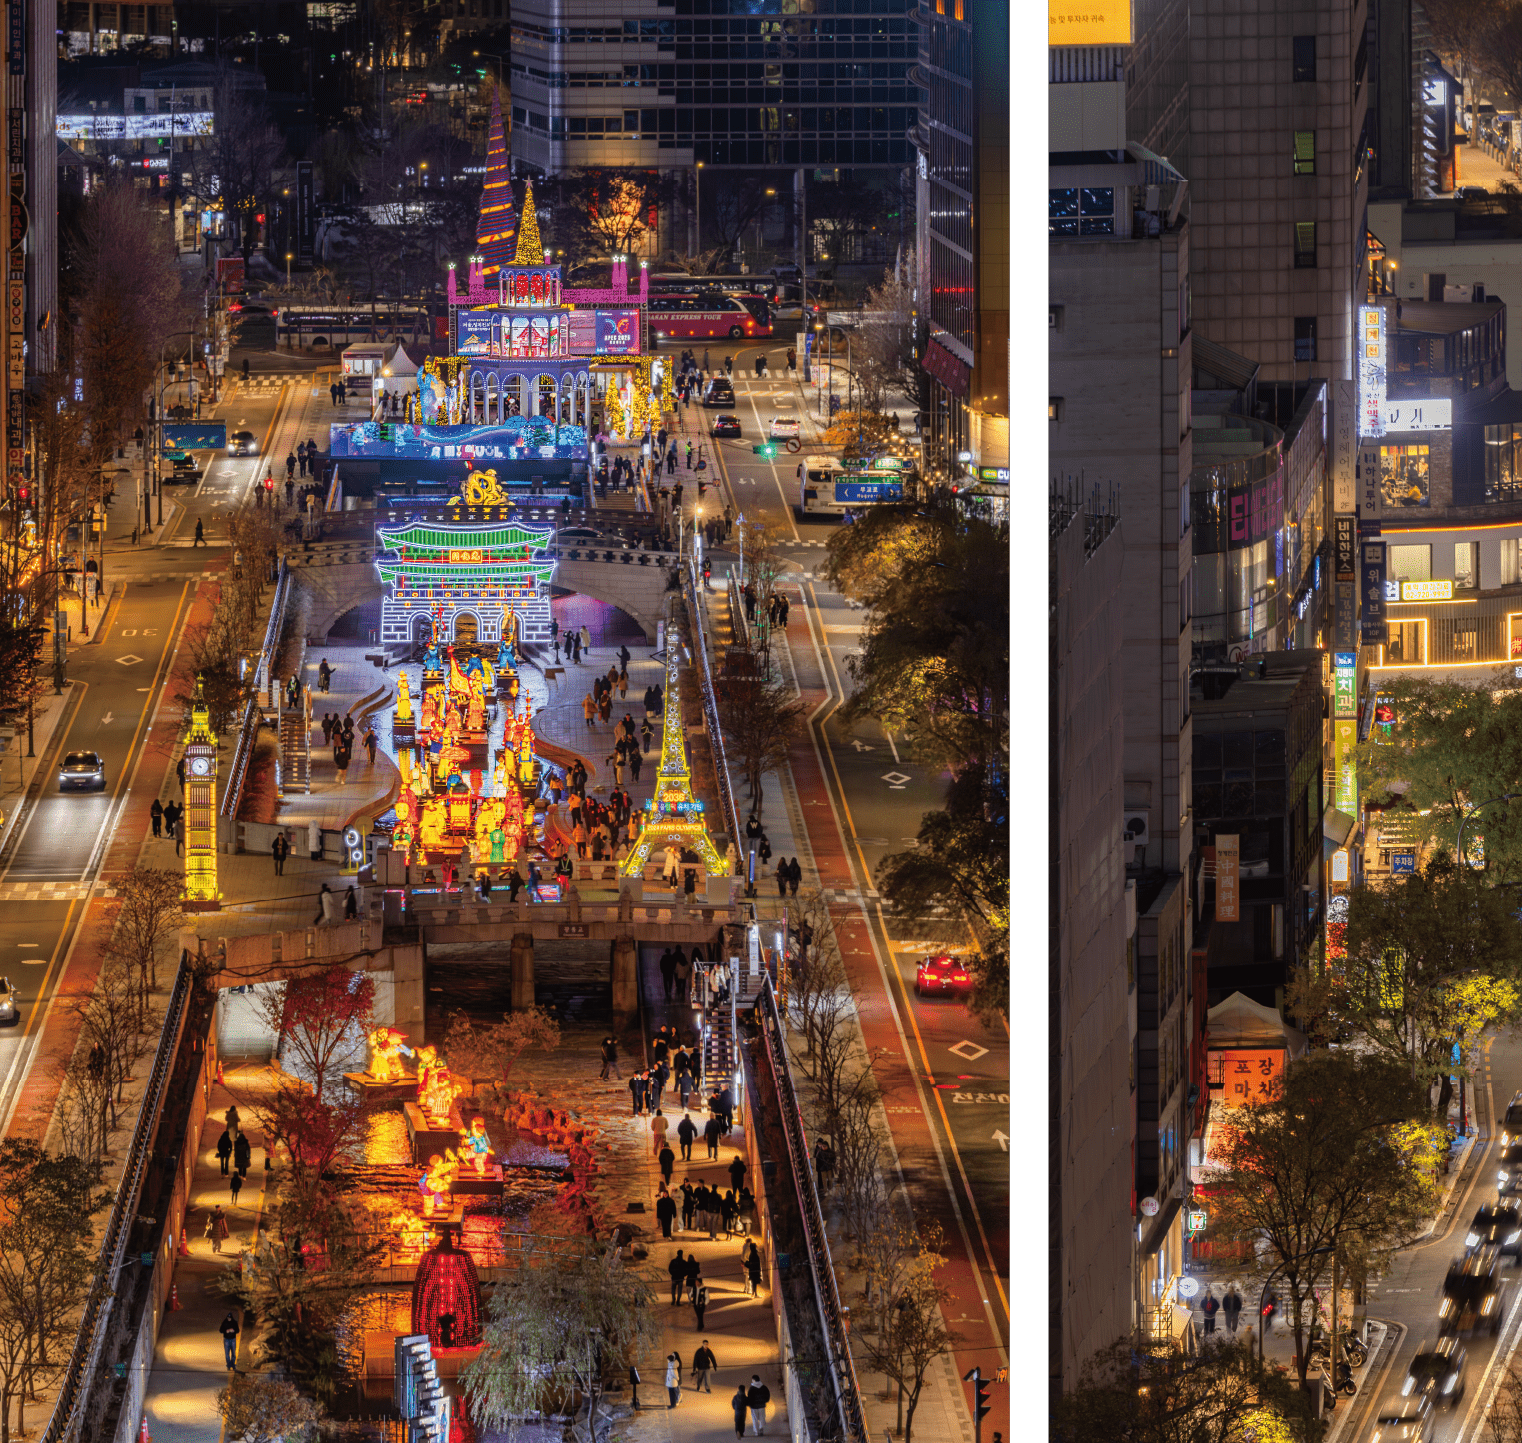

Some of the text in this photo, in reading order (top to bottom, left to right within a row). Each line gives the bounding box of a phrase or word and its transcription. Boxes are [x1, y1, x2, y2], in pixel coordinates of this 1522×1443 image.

[11, 205, 21, 239] BAR
[1365, 466, 1377, 511] 하나투어
[1338, 521, 1351, 572] 비어하우스
[1367, 568, 1380, 615] 위솔브
[1337, 679, 1354, 708] 치과
[662, 793, 686, 802] 2036
[1220, 859, 1235, 918] 中國料理
[1234, 1057, 1275, 1076] 포장
[1234, 1080, 1275, 1098] 마차
